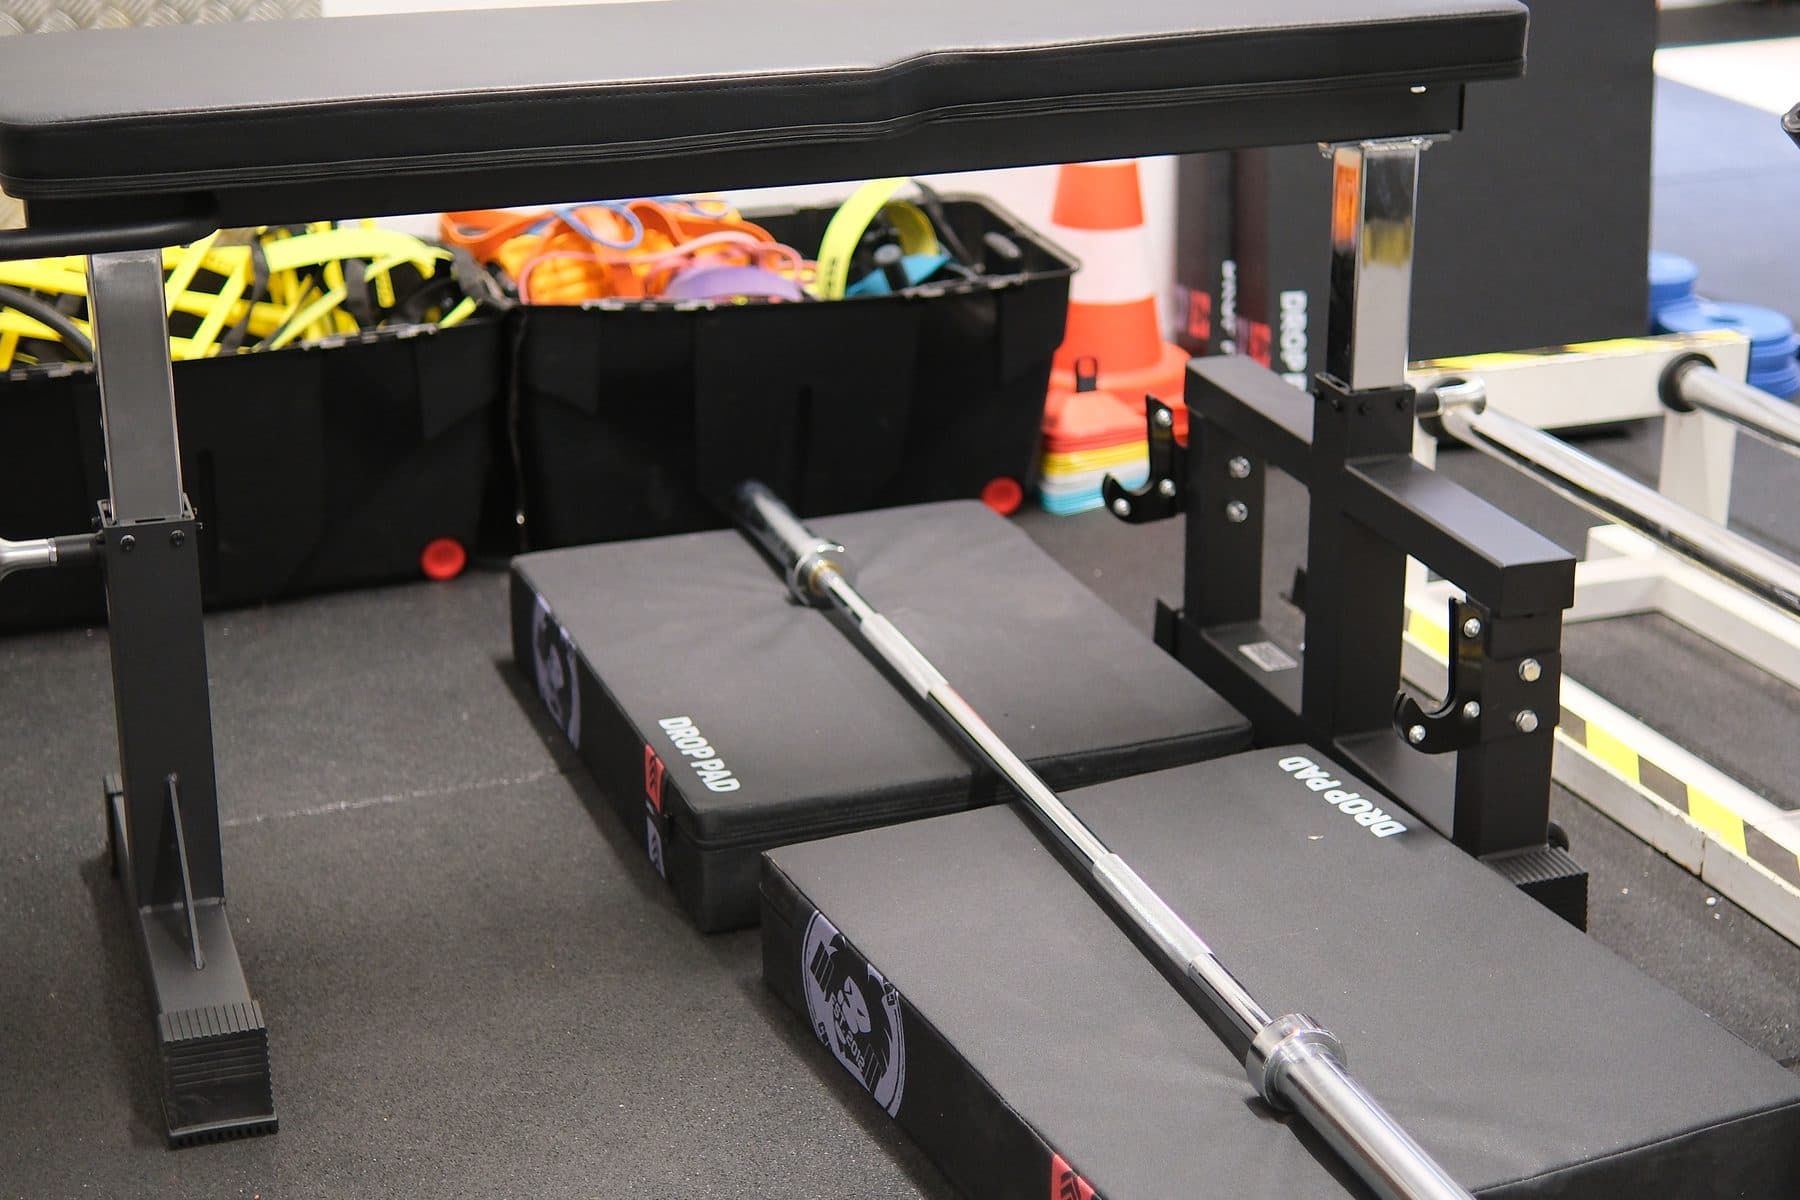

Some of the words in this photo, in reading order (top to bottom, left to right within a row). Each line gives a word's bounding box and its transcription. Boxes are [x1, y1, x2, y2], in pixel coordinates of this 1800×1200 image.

[1280, 290, 1307, 372] DROP
[658, 716, 716, 759] DROP
[690, 758, 741, 792] PAD
[1278, 756, 1342, 792] PAD
[1323, 789, 1407, 838] DROP
